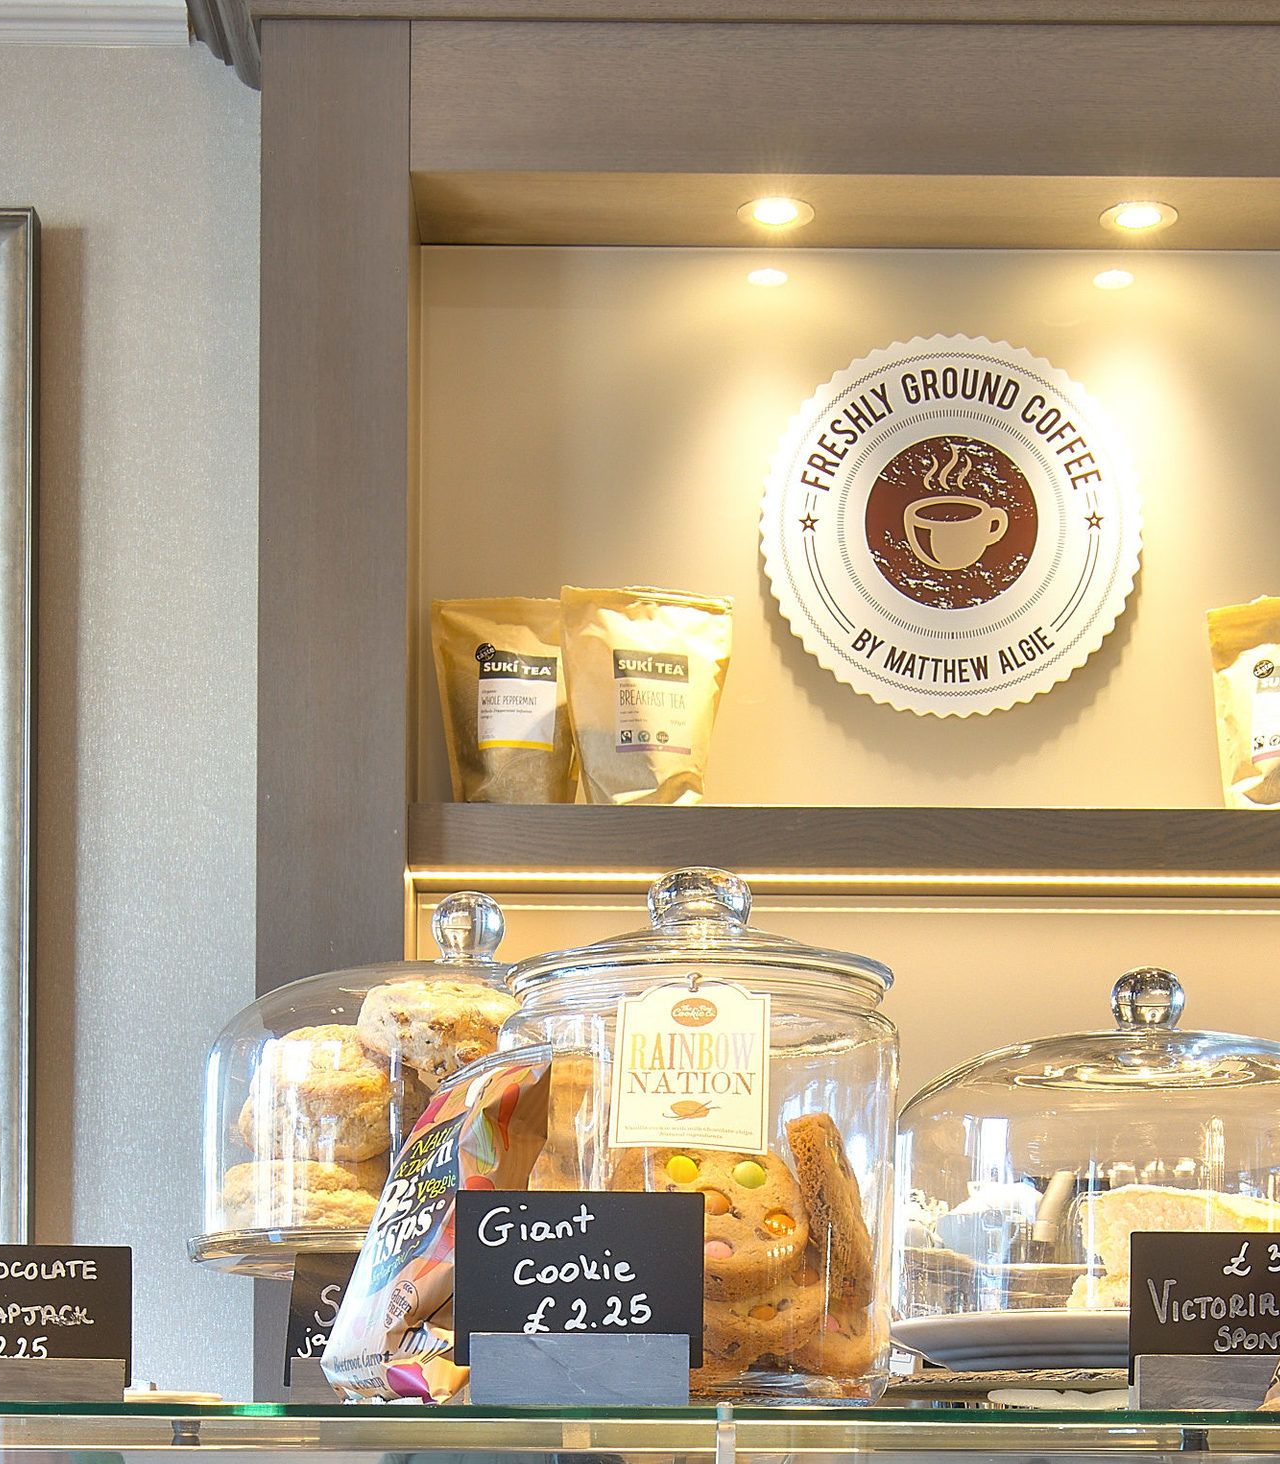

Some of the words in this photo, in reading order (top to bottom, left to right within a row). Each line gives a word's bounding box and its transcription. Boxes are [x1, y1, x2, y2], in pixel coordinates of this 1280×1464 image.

[800, 382, 895, 492] FRESHLY
[901, 367, 1021, 411] GROUND
[1020, 394, 1102, 491] COFFEE
[522, 665, 552, 676] TEA
[655, 662, 686, 676] TEA
[851, 627, 886, 660] BY
[884, 645, 990, 685] MATTHEW
[998, 625, 1056, 675] ALGIE
[619, 689, 665, 706] BREAKFAST
[670, 693, 686, 710] TEA
[629, 1032, 757, 1070] RAINBOW
[627, 1071, 756, 1095] NATION
[478, 1205, 594, 1247] Giant
[514, 1250, 637, 1287] Cookie
[1224, 1243, 1253, 1277] £
[391, 1290, 413, 1313] Gluten
[523, 1297, 551, 1335] £
[563, 1292, 653, 1332] 2.25
